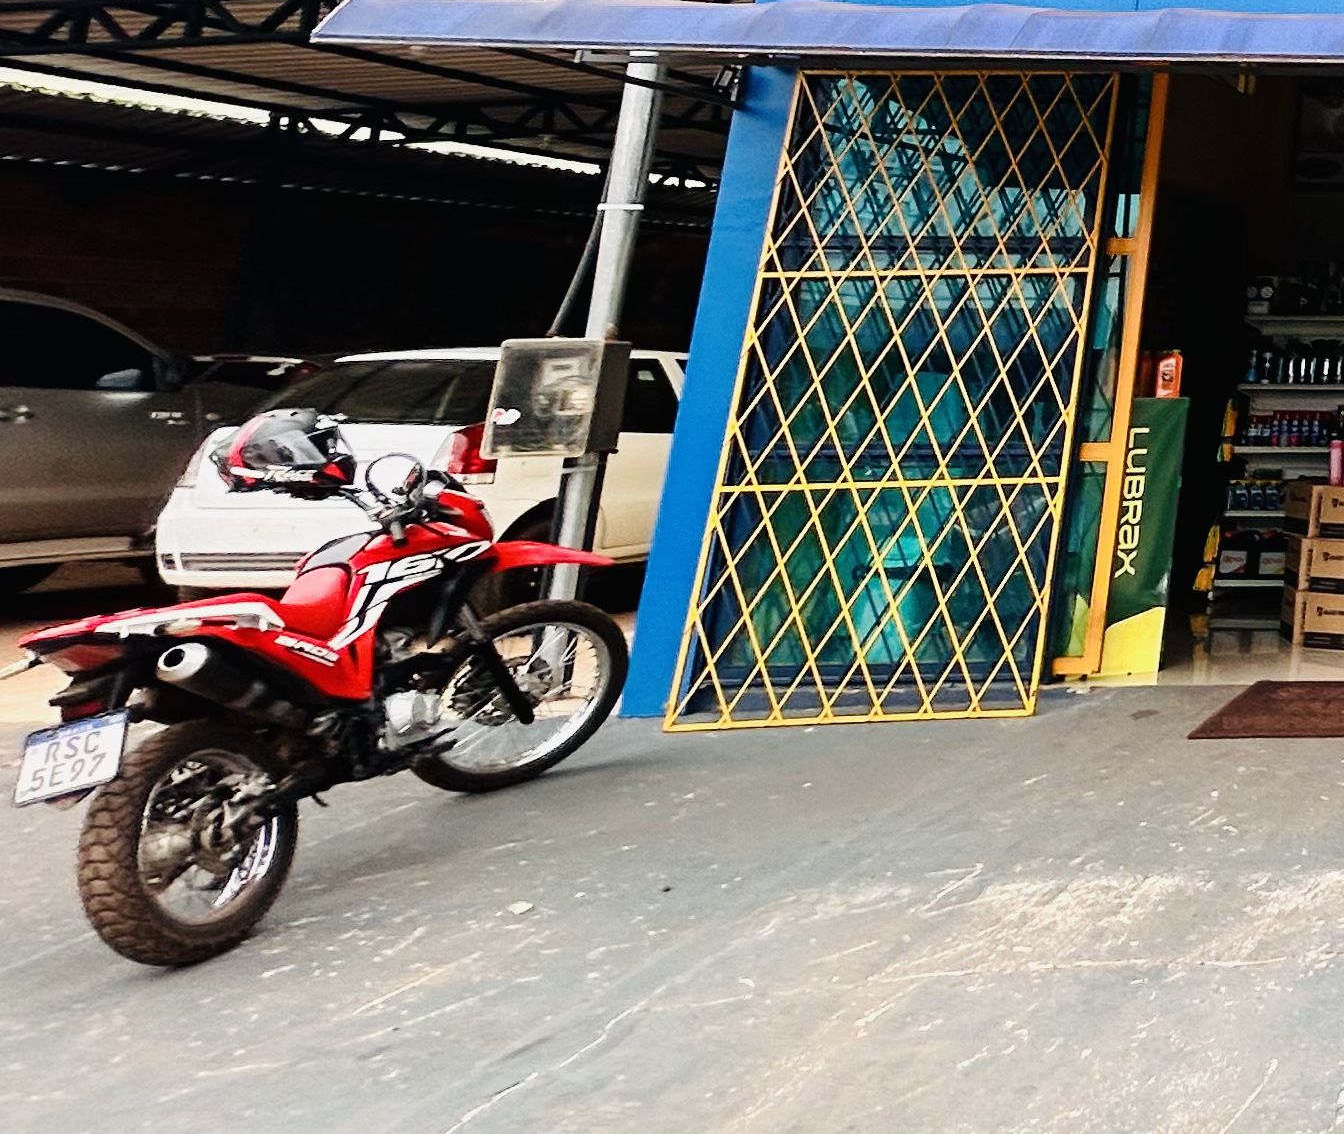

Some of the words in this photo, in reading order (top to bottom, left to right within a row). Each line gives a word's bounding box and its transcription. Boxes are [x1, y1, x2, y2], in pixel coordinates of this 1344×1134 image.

[357, 540, 492, 584] 160
[44, 730, 101, 766] RSC
[30, 752, 107, 792] 5E97
